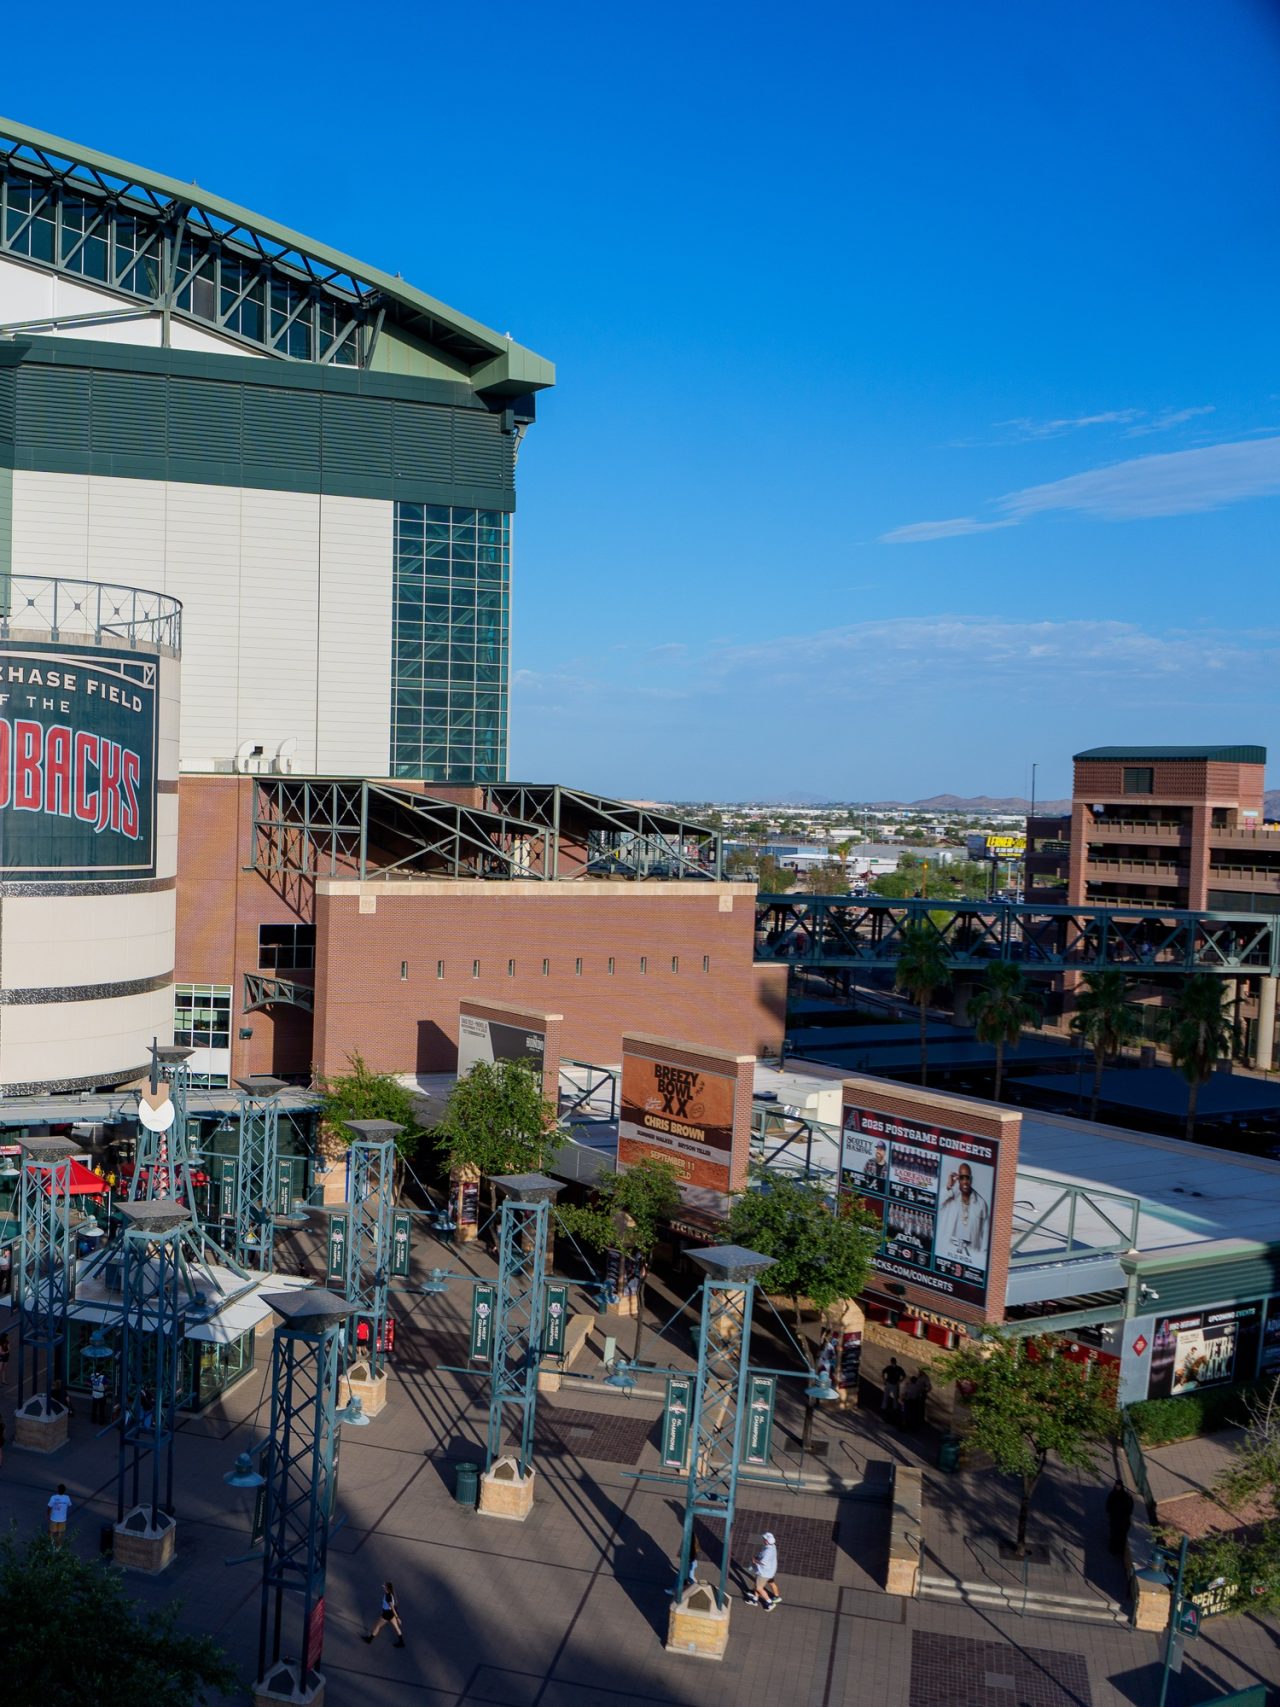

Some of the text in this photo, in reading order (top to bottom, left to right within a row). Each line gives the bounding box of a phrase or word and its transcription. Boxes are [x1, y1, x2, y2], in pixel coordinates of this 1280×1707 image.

[26, 696, 70, 713] THE
[87, 679, 142, 712] FIELD
[655, 1064, 699, 1087] BREEZY
[658, 1079, 693, 1100] BOWL
[644, 1115, 705, 1141] CHRIS BROWN
[862, 1118, 992, 1158] 2025 POSTGAME CONCERTS
[650, 1151, 695, 1170] SEPTEMBER 11
[906, 1305, 967, 1334] TICKETS
[669, 1418, 677, 1451] CHAMPIONS
[752, 1415, 760, 1448] CHAMPIONS
